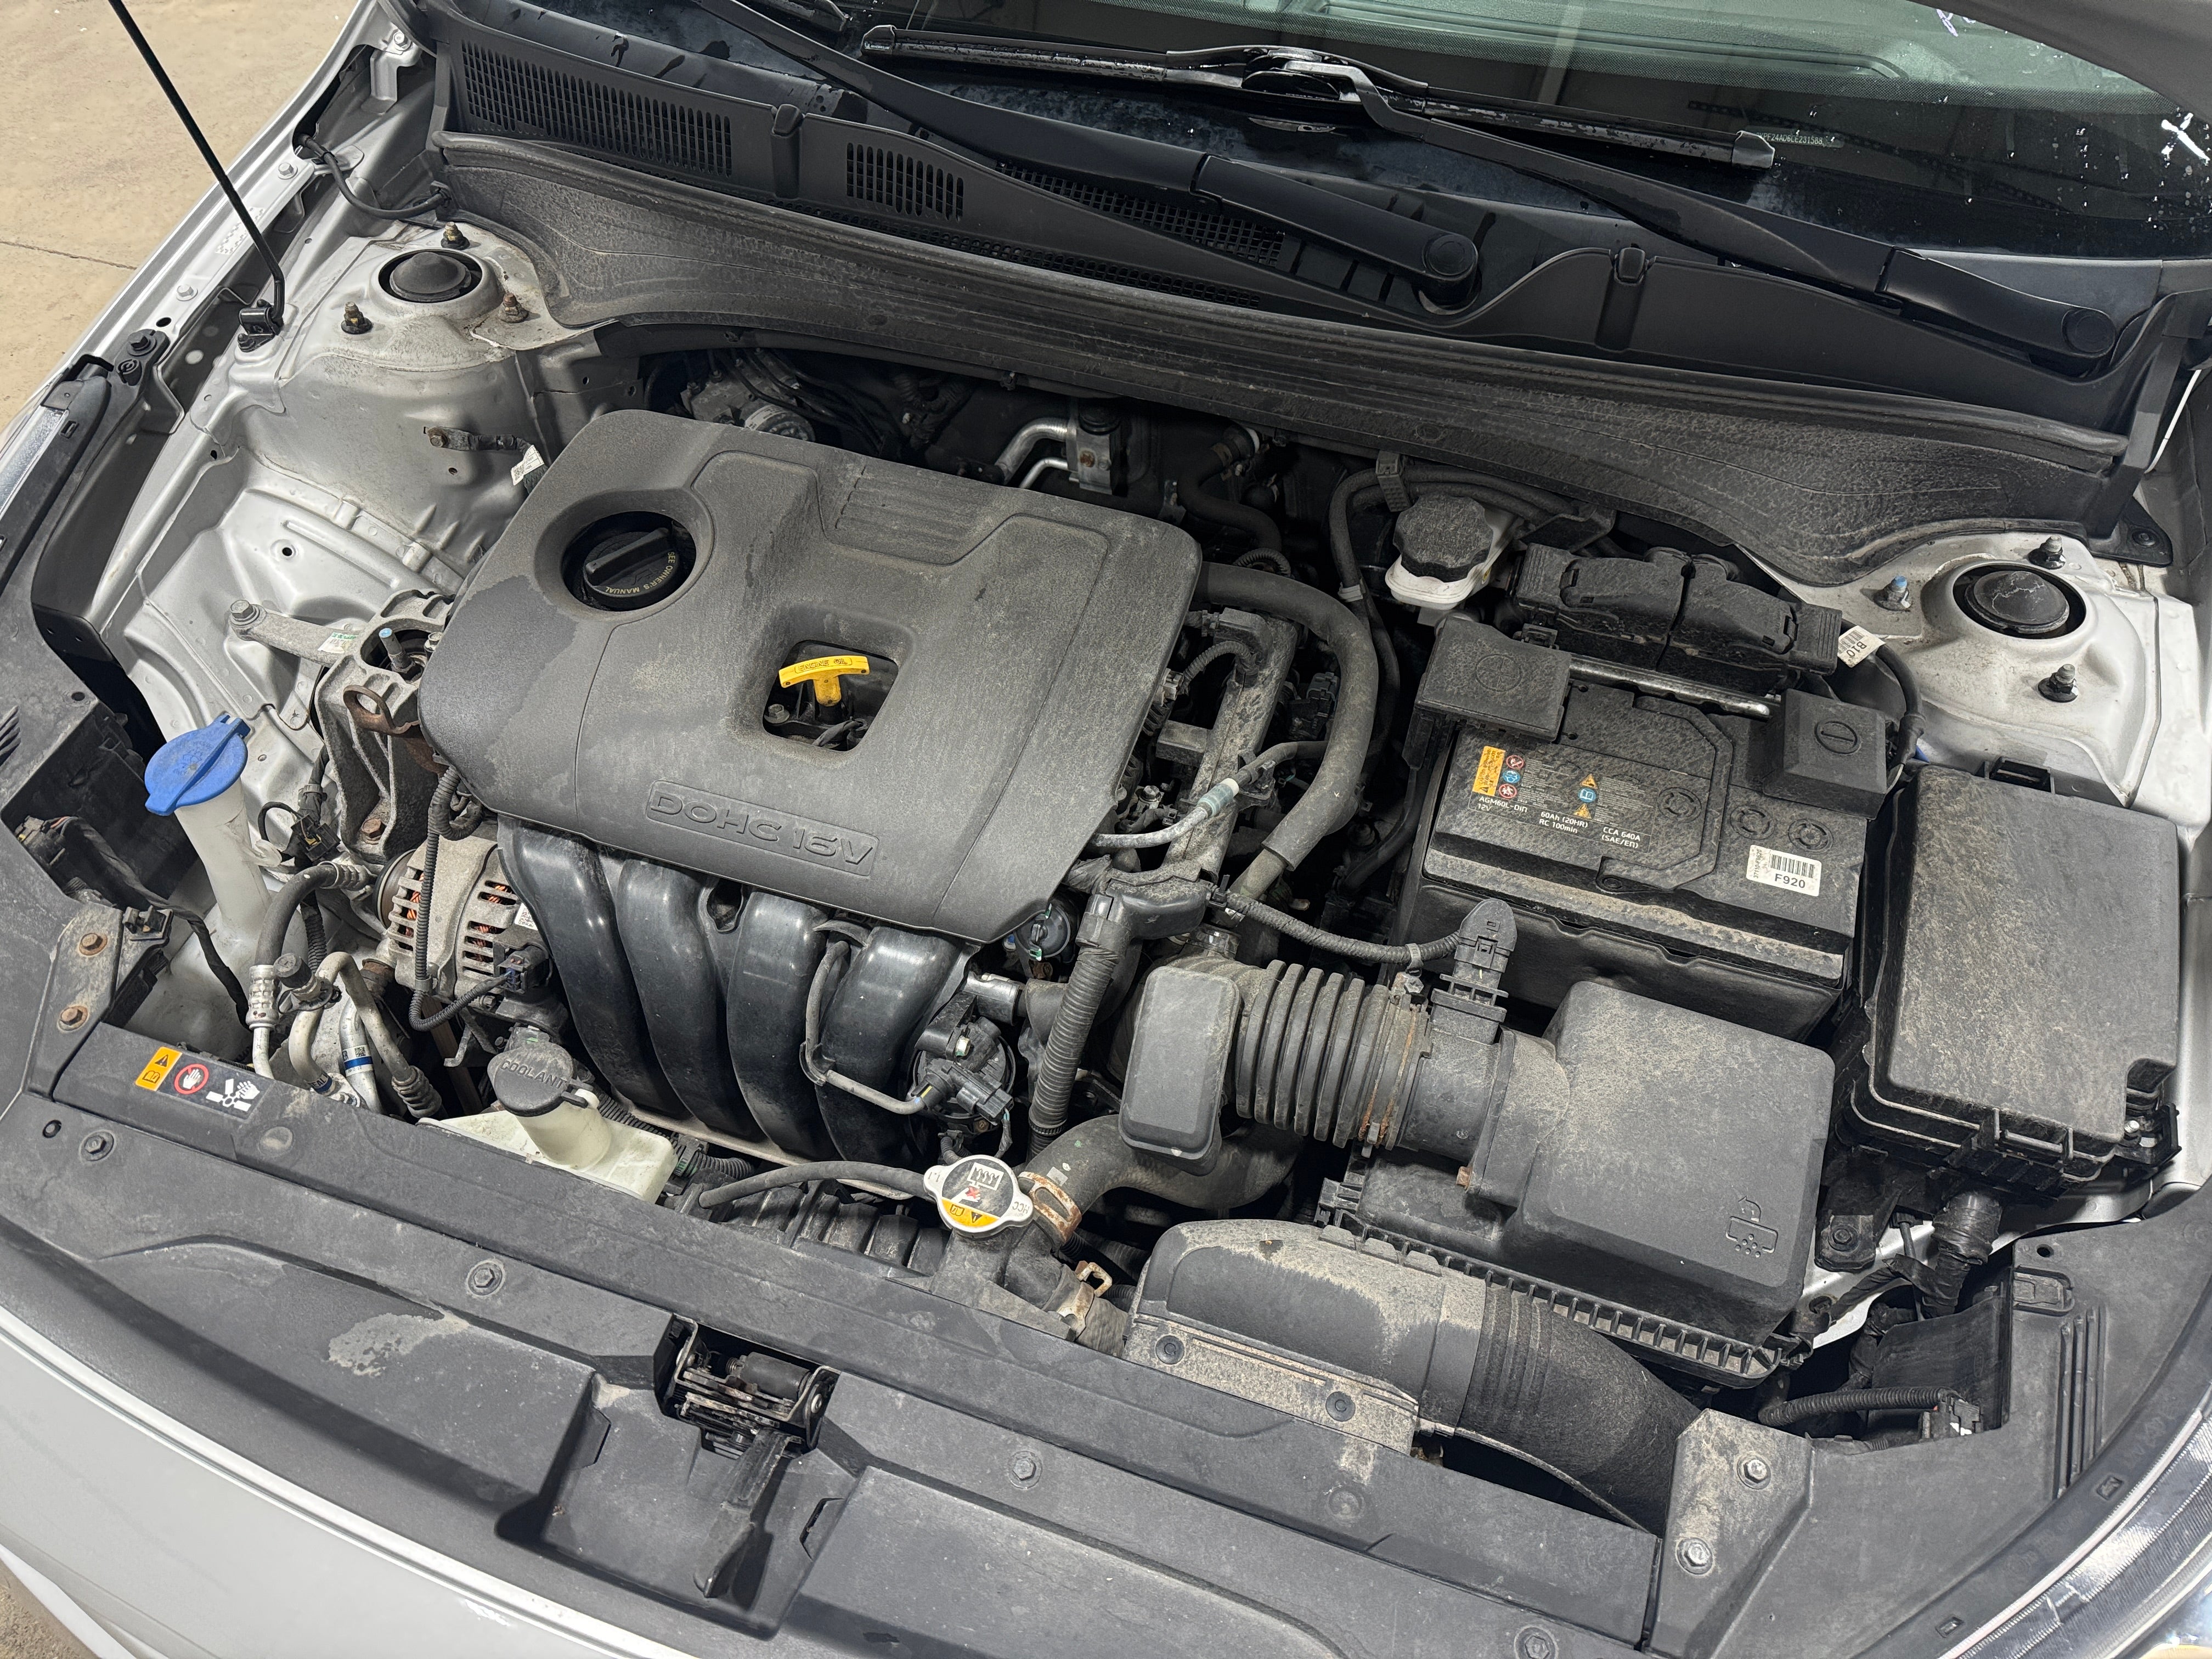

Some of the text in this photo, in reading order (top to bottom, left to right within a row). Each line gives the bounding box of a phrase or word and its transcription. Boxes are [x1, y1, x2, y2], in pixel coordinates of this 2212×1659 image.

[605, 551, 676, 594] SEE OWNER'S MANUAL
[1846, 641, 1867, 657] B10
[798, 659, 830, 672] ENGINE
[1477, 803, 1492, 812] 12V
[1539, 819, 1578, 834] RC 100min
[1540, 811, 1588, 828] 60Ah (20HR)
[650, 793, 873, 865] DOHC 16V
[1602, 826, 1641, 842] CCA 640A
[1774, 873, 1806, 889] F920
[499, 1059, 568, 1090] COOLANT
